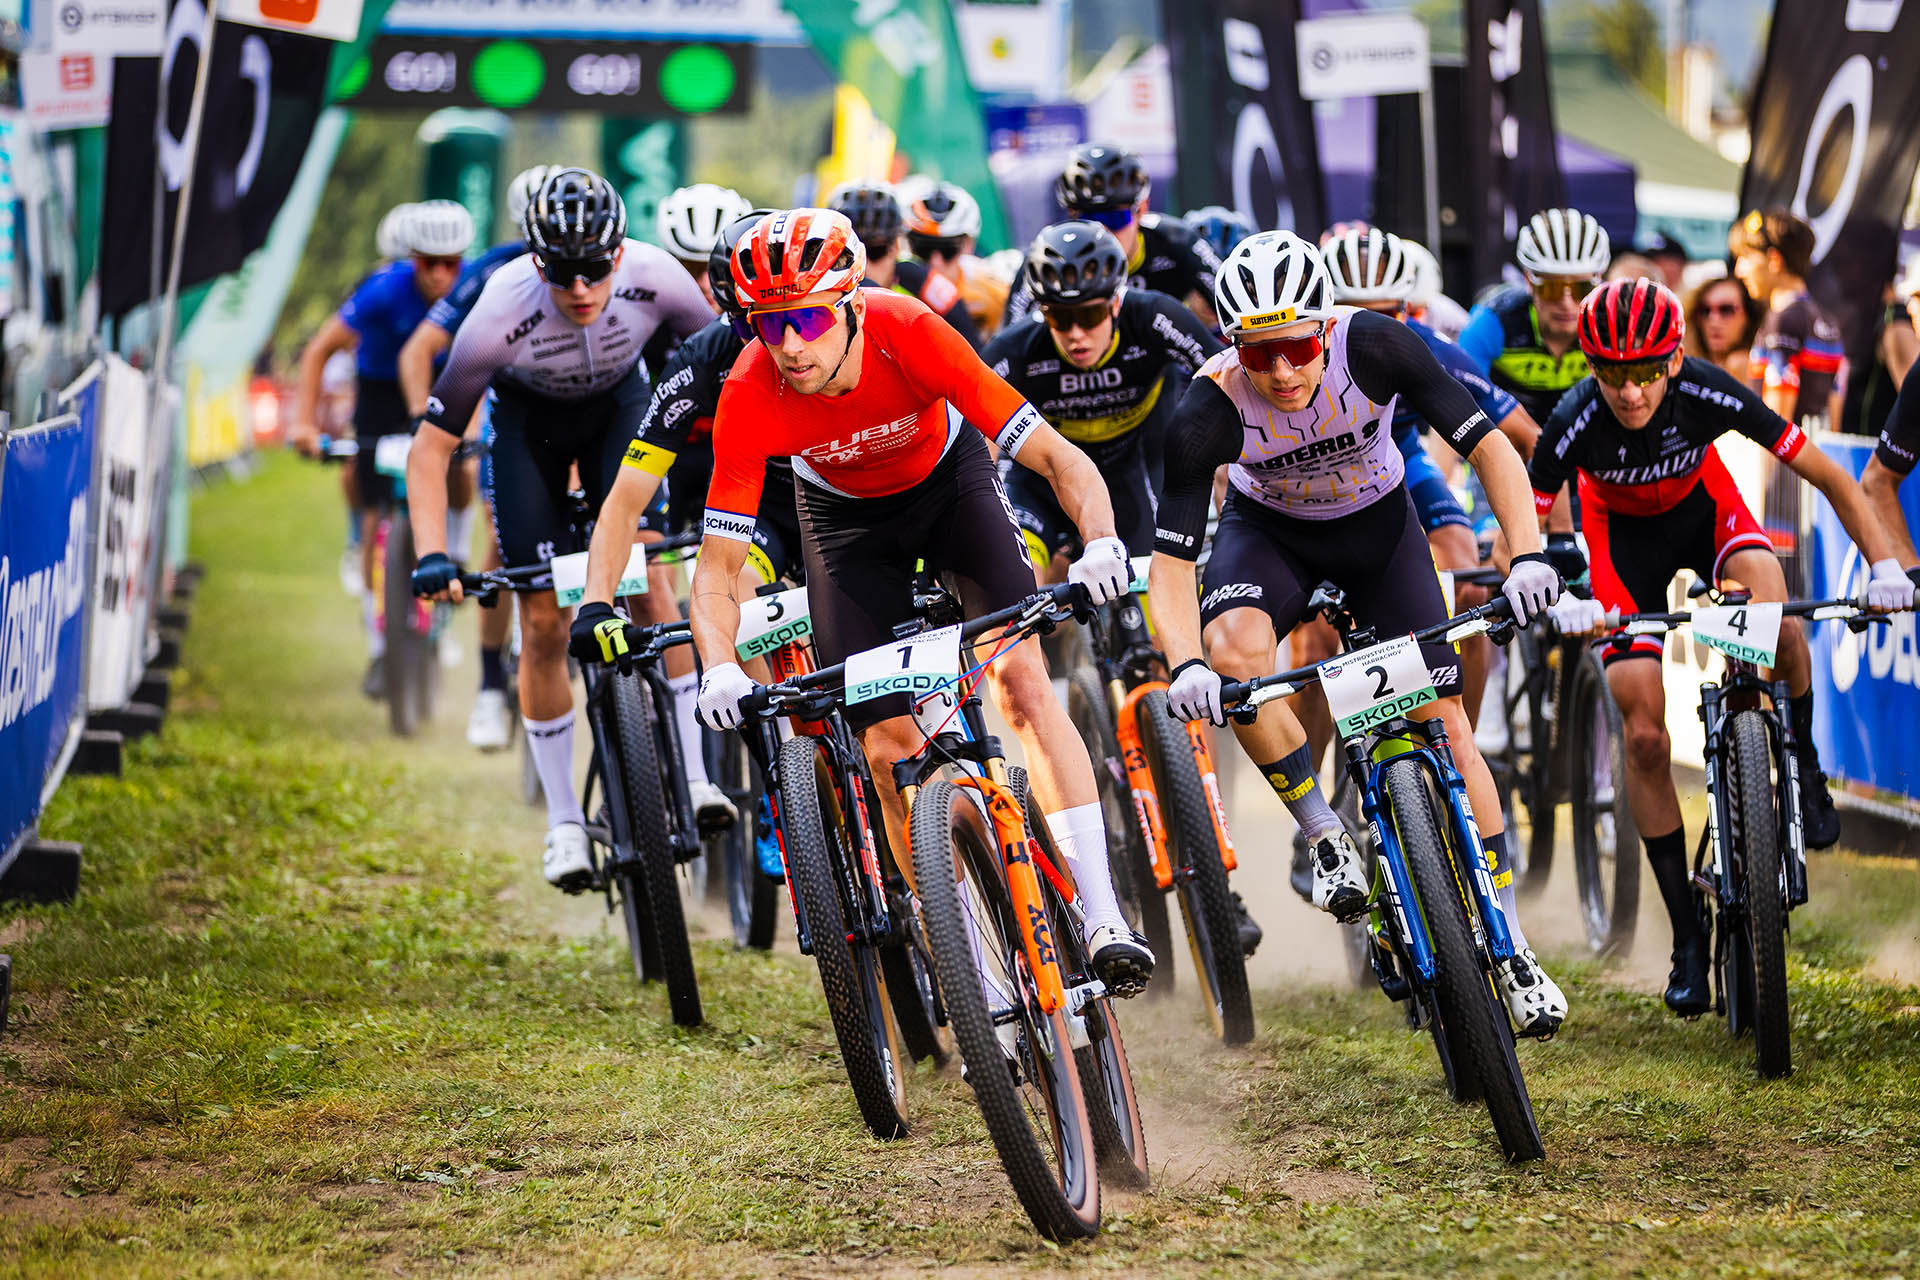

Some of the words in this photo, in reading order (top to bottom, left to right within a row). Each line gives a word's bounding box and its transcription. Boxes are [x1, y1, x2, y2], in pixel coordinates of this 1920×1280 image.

[505, 309, 546, 345] LAZER
[656, 365, 694, 400] Energy
[800, 412, 918, 456] CUBE
[811, 445, 863, 464] FOX
[705, 517, 753, 536] SCHWAL
[762, 594, 784, 622] 3
[1728, 609, 1748, 636] 4
[897, 645, 913, 669] 1
[1362, 650, 1402, 666] HARRACHOV
[1365, 665, 1395, 700] 2
[1028, 904, 1057, 966] FOX
